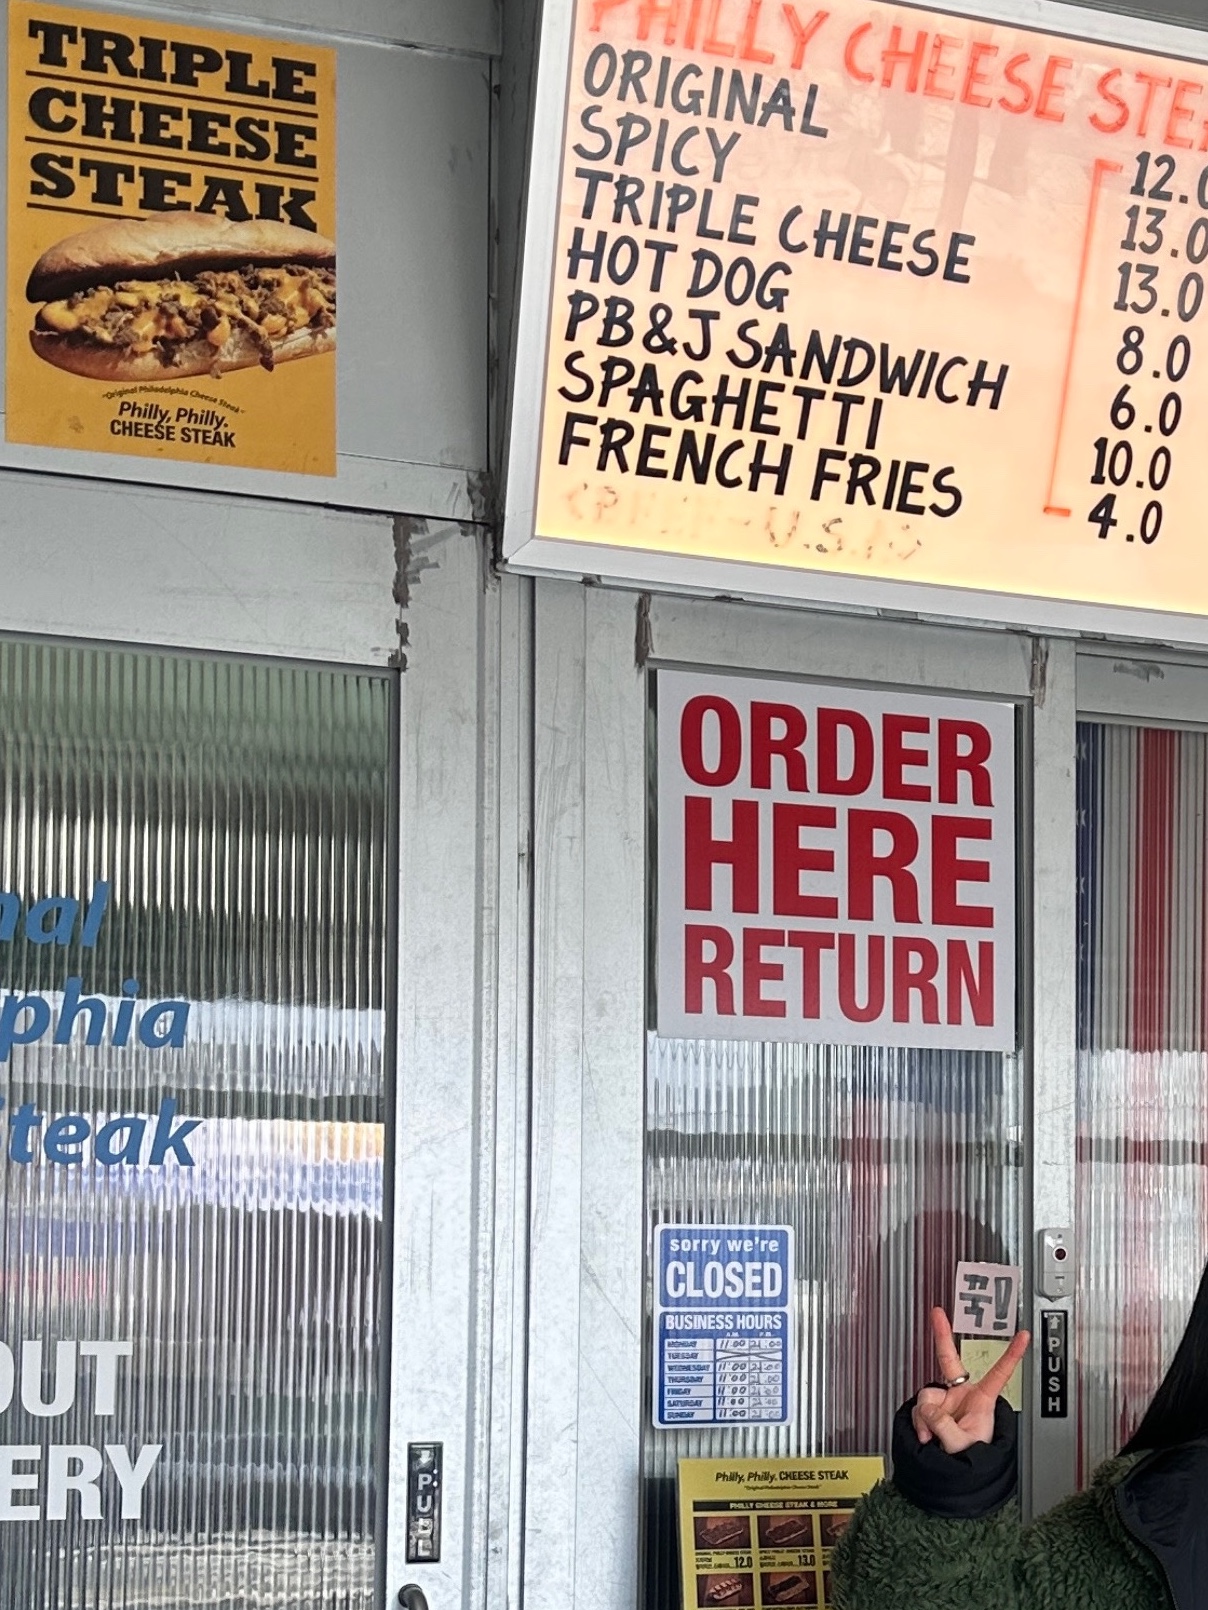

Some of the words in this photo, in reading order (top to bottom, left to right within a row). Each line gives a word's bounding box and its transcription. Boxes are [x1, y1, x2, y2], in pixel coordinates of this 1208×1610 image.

[28, 19, 317, 105] TRIPLE
[584, 44, 828, 138] ORIGINAL
[846, 22, 1072, 122] CHEESE
[28, 87, 317, 169] CHEESE
[574, 105, 741, 182] SPICY
[30, 152, 317, 233] STEAK
[574, 169, 759, 245] TRIPLE
[779, 206, 976, 284] CHEESE
[1112, 262, 1203, 322] 13.0
[567, 230, 678, 291] HOT
[687, 253, 792, 312] DOG
[1117, 325, 1191, 382] 8.0
[566, 294, 720, 359] PB&J
[728, 324, 1009, 411] SANDWICH
[1110, 382, 1181, 436] 6.0
[110, 420, 175, 441] CHEESE
[181, 427, 236, 447] STEAK
[118, 401, 171, 425] Philly,
[176, 407, 228, 431] Philly.
[558, 351, 882, 450] SPAGHETTI
[1091, 437, 1172, 491] 10.0
[558, 412, 792, 496] FRENCH
[811, 449, 962, 517] FRIES
[1089, 502, 1162, 545] 4.0
[680, 694, 995, 807] ORDER
[684, 795, 994, 928] HERE
[684, 923, 994, 1027] RETURN
[666, 1261, 782, 1299] CLOSED
[669, 1238, 721, 1256] sorry
[727, 1237, 779, 1252] we're
[665, 1315, 734, 1330] BUSINESS
[737, 1314, 782, 1329] HOURS
[1048, 1337, 1061, 1412] PUSH
[779, 1471, 815, 1481] CHEESE
[818, 1470, 849, 1480] STEAK
